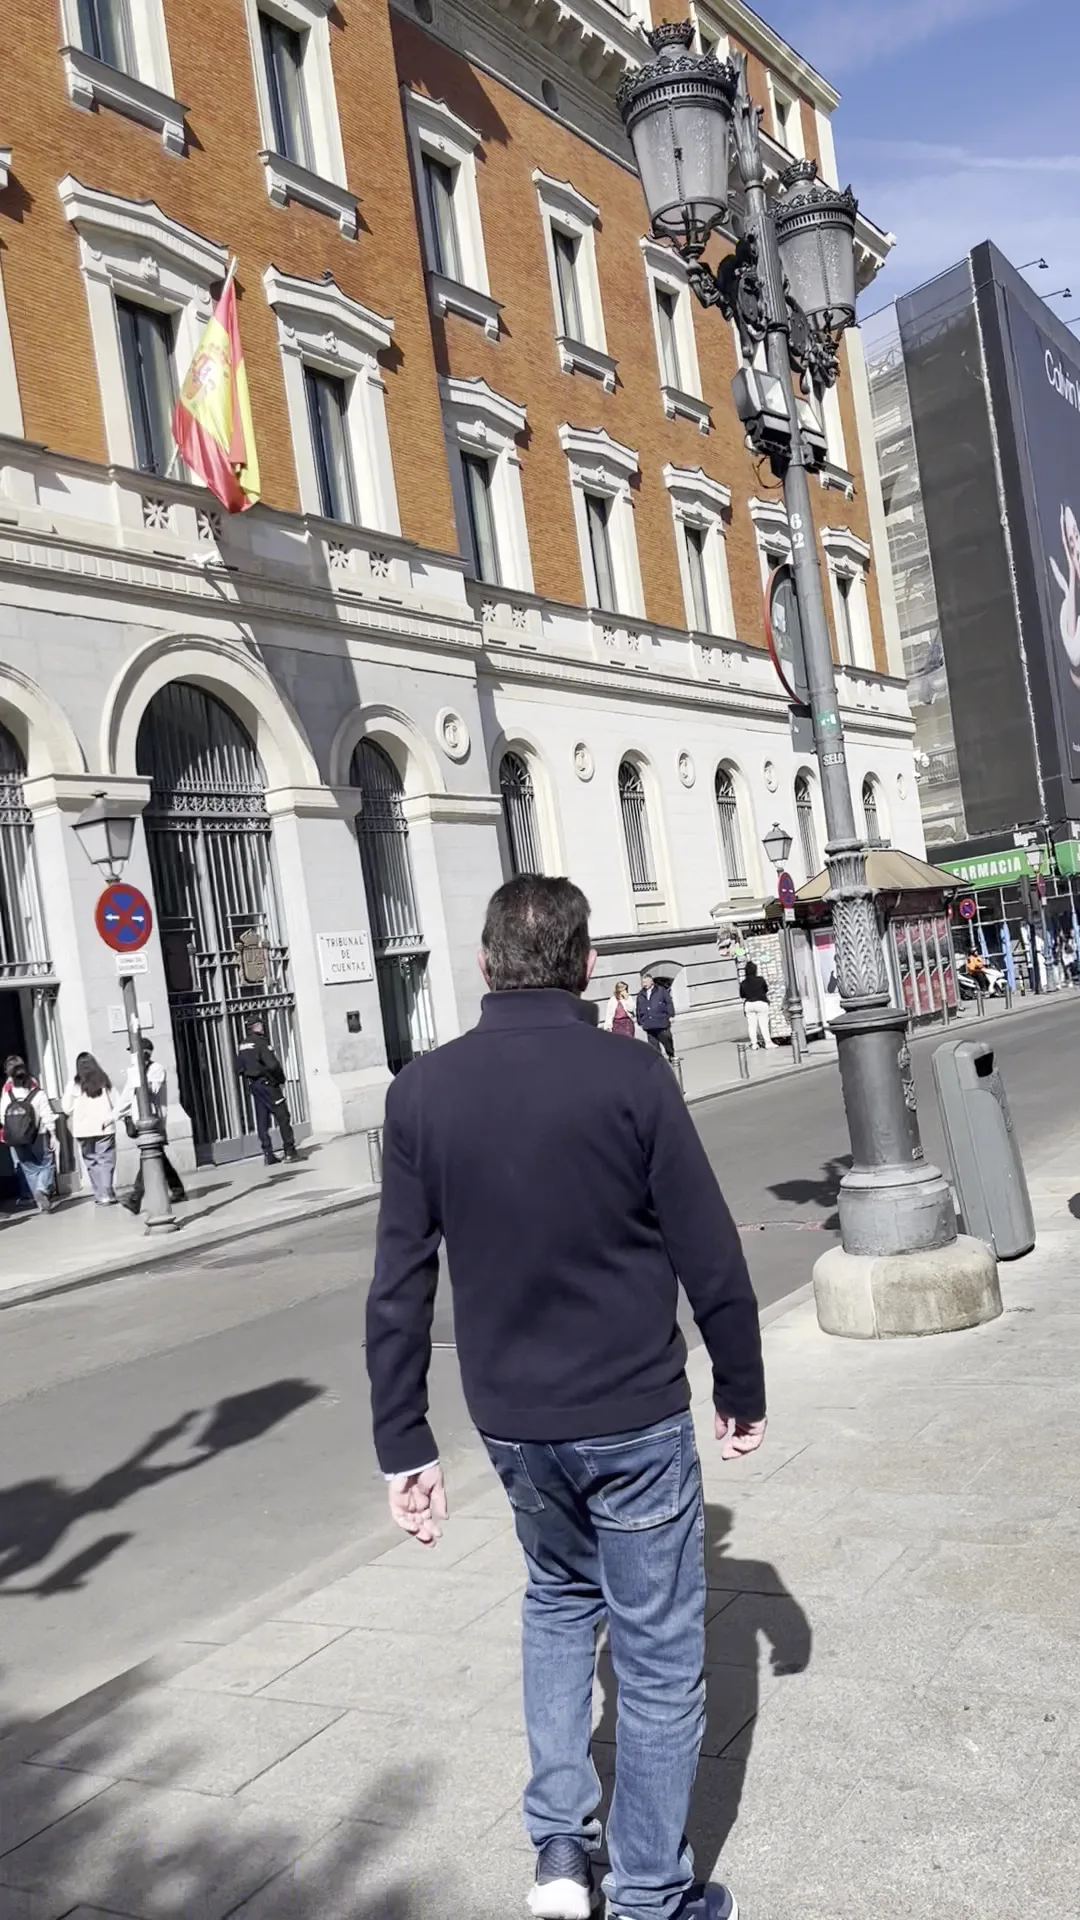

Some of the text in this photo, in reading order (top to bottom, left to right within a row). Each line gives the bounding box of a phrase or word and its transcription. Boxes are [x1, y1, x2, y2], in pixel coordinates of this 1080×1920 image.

[1045, 349, 1077, 409] Calvin
[953, 857, 1021, 881] FARMACIA
[325, 936, 363, 948] TRIBUNAL
[341, 949, 351, 959] DE
[332, 962, 365, 973] CUENTAS
